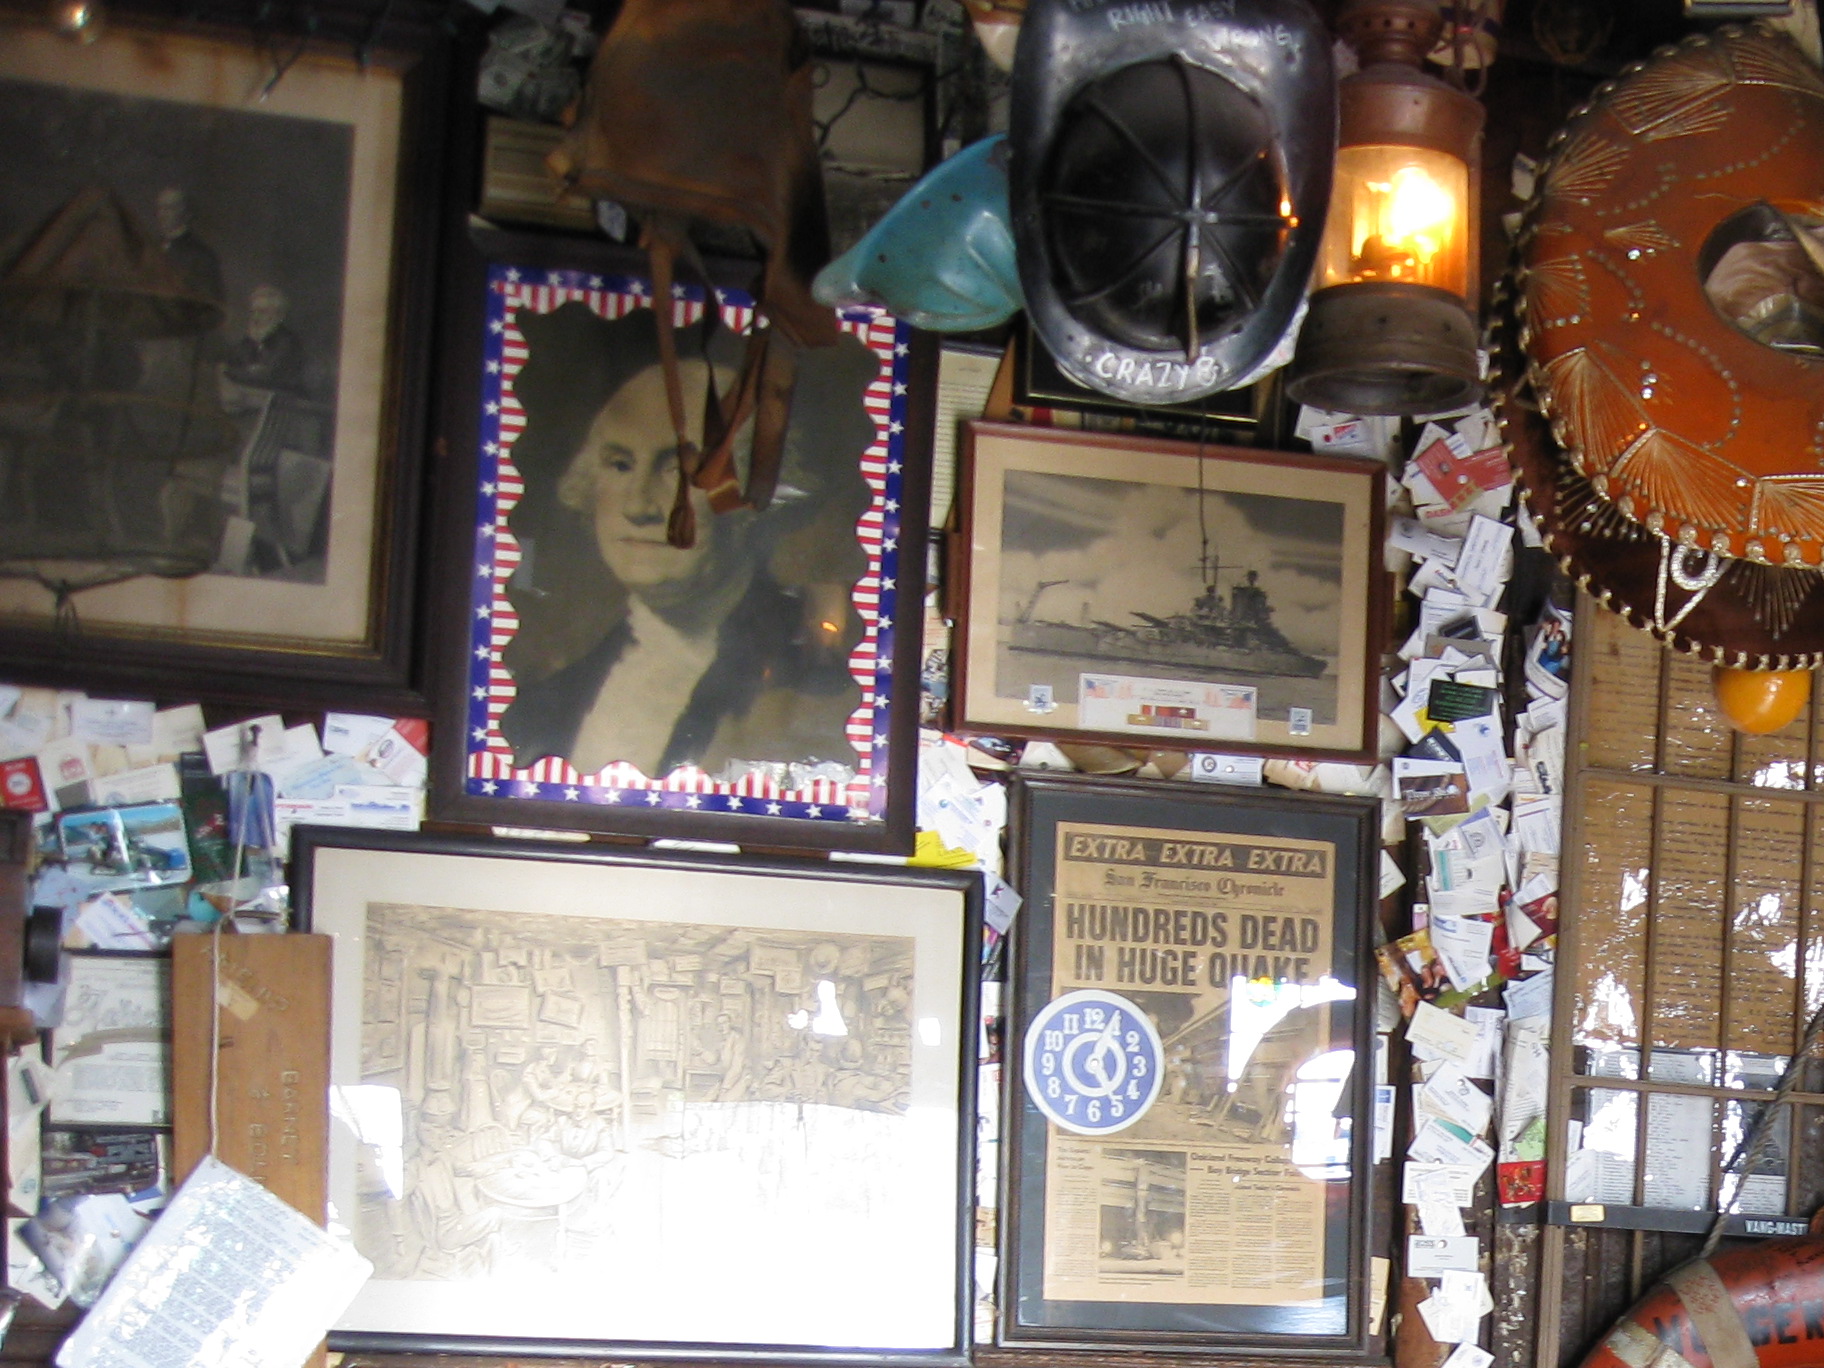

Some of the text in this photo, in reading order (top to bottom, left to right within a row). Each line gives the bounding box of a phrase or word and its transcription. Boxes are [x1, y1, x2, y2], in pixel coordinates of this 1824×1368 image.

[1070, 836, 1322, 874] EXTRA EXTRA EXTRA
[1104, 868, 1285, 898] San Francisco Chronicle
[1066, 902, 1320, 954] HUNDREDS DEAD
[1074, 944, 1104, 981] IN
[1117, 946, 1198, 986] HUGE
[1083, 1008, 1106, 1030] 12
[1044, 1030, 1065, 1052] 10
[1125, 1031, 1141, 1052] 2
[1041, 1052, 1056, 1076] 9
[1132, 1055, 1147, 1077] 3
[1047, 1076, 1062, 1099] 8
[1126, 1079, 1141, 1100] 4
[1064, 1094, 1080, 1116] 7
[1086, 1099, 1102, 1122] 6
[1110, 1095, 1125, 1117] 5
